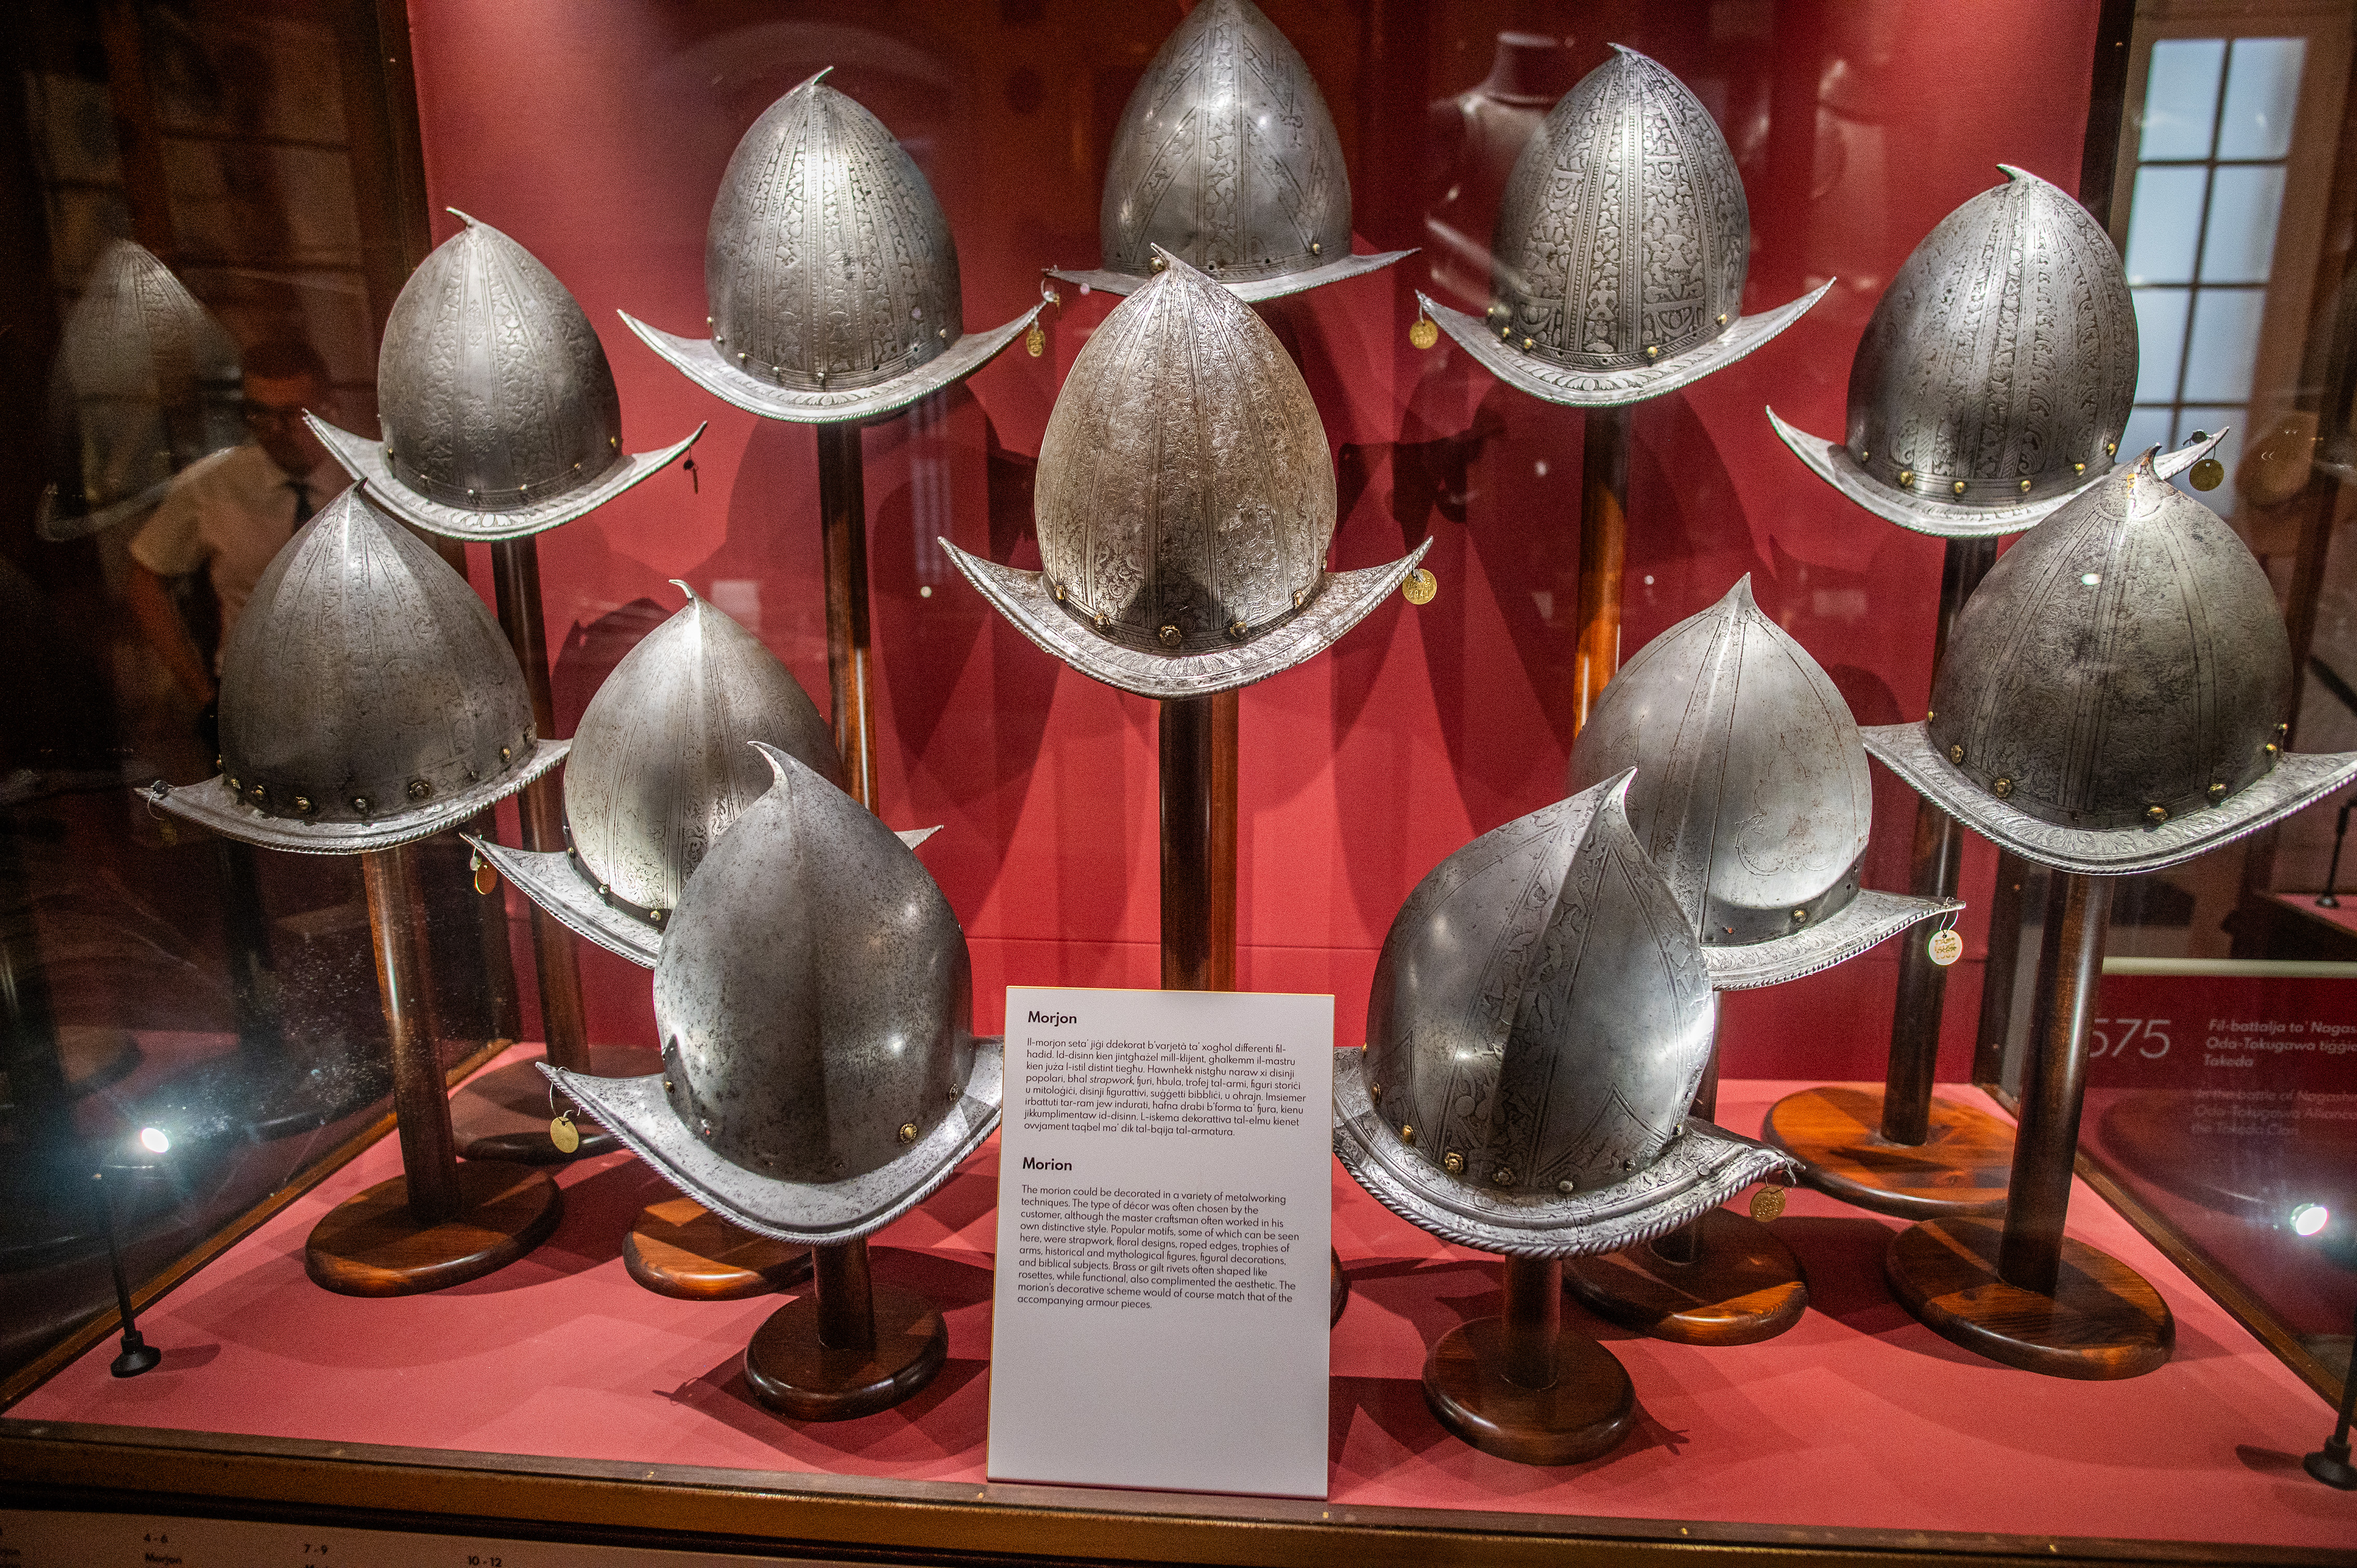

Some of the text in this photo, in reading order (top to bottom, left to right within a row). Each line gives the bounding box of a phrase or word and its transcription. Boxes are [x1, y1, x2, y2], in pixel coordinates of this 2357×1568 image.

[1409, 590, 1429, 598] 3941
[1027, 1011, 1077, 1028] Morjon
[2311, 1021, 2357, 1037] Nagas
[1027, 1037, 1066, 1049] Il-morjon
[1090, 1039, 1104, 1051] jiġi
[1106, 1039, 1146, 1049] ddekorat
[1202, 1042, 1233, 1054] xogħol
[1234, 1042, 1273, 1054] differenti
[1276, 1043, 1286, 1053] fil-
[1026, 1048, 1295, 1066] ħadid. Id-disinn kien jintgħażel mill-klijent, għalkemm il-mastru
[2204, 1054, 2254, 1068] Takeda
[1026, 1060, 1043, 1071] kien
[1044, 1064, 1064, 1073] juża
[1066, 1062, 1086, 1072] l-istil
[1088, 1062, 1114, 1072] distint
[1116, 1063, 1145, 1075] tiegħu.
[1147, 1064, 1193, 1075] Hawnhekk
[1195, 1066, 1226, 1078] nistgħu
[1260, 1069, 1267, 1077] xi
[1269, 1068, 1294, 1080] disinji
[1026, 1072, 1065, 1084] popolari,
[1067, 1073, 1088, 1084] bħal
[1089, 1075, 1135, 1086] strapwork,
[1156, 1076, 1184, 1087] ħbula,
[1186, 1077, 1209, 1090] trofej
[1211, 1078, 1248, 1089] tal-armi,
[1251, 1079, 1273, 1092] figuri
[1275, 1081, 1301, 1091] storiċi
[1032, 1084, 1077, 1097] mitoloġiċi,
[1079, 1085, 1104, 1098] disinji
[1106, 1086, 1148, 1099] figurattivi,
[1150, 1088, 1186, 1100] suġġetti
[1188, 1089, 1223, 1100] bibbliċi,
[1232, 1091, 1263, 1104] oħrajn.
[1266, 1092, 1306, 1102] Imsiemer
[1024, 1108, 1299, 1127] jikkumplimentaw id-disinn. L-iskema dekorattiva tal-elmu kienet
[1024, 1121, 1069, 1132] ovvjament
[1071, 1121, 1101, 1133] taqbel
[1121, 1123, 1134, 1133] dik
[1135, 1123, 1174, 1136] tal-bqija
[1176, 1125, 1235, 1136] tal-armatura.
[1022, 1156, 1072, 1172] Morion
[1022, 1184, 1038, 1194] The
[1040, 1187, 1071, 1195] morion
[1073, 1186, 1098, 1197] could
[1100, 1187, 1112, 1198] be
[1114, 1187, 1161, 1199] decorated
[1163, 1190, 1171, 1199] in
[1181, 1192, 1212, 1203] variety
[1213, 1191, 1224, 1201] of
[1225, 1192, 1286, 1206] metalworking
[1021, 1197, 1070, 1209] techniques.
[1072, 1198, 1089, 1208] The
[1091, 1200, 1110, 1211] type
[1112, 1199, 1122, 1210] of
[1123, 1200, 1150, 1211] décor
[1172, 1202, 1195, 1212] often
[1196, 1202, 1228, 1214] chosen
[1230, 1203, 1242, 1216] by
[1244, 1204, 1259, 1215] the
[1021, 1210, 1284, 1228] customer, although the master craftsman often worked in his
[1041, 1221, 1085, 1232] distinctive
[1087, 1224, 1109, 1235] style.
[1111, 1224, 1146, 1236] Popular
[1147, 1226, 1176, 1237] motifs,
[1204, 1227, 1214, 1238] of
[1215, 1228, 1242, 1239] which
[1264, 1229, 1276, 1240] be
[1019, 1232, 1042, 1243] here,
[1068, 1235, 1115, 1247] strapwork,
[1117, 1235, 1139, 1247] floral
[1141, 1237, 1177, 1251] designs,
[1180, 1240, 1207, 1252] roped
[1209, 1240, 1240, 1253] edges,
[1242, 1242, 1278, 1254] trophies
[1280, 1242, 1290, 1253] of
[1019, 1245, 1286, 1266] arms, historical and mythological figures, figural decorations,
[1056, 1283, 1105, 1295] decorative
[1107, 1285, 1141, 1296] scheme
[1143, 1287, 1171, 1297] would
[1173, 1287, 1183, 1298] of
[1184, 1291, 1215, 1299] course
[1216, 1290, 1245, 1300] match
[1247, 1291, 1265, 1302] that
[1267, 1292, 1277, 1302] of
[1278, 1293, 1293, 1303] the
[1017, 1296, 1153, 1310] accompanying armour pieces.
